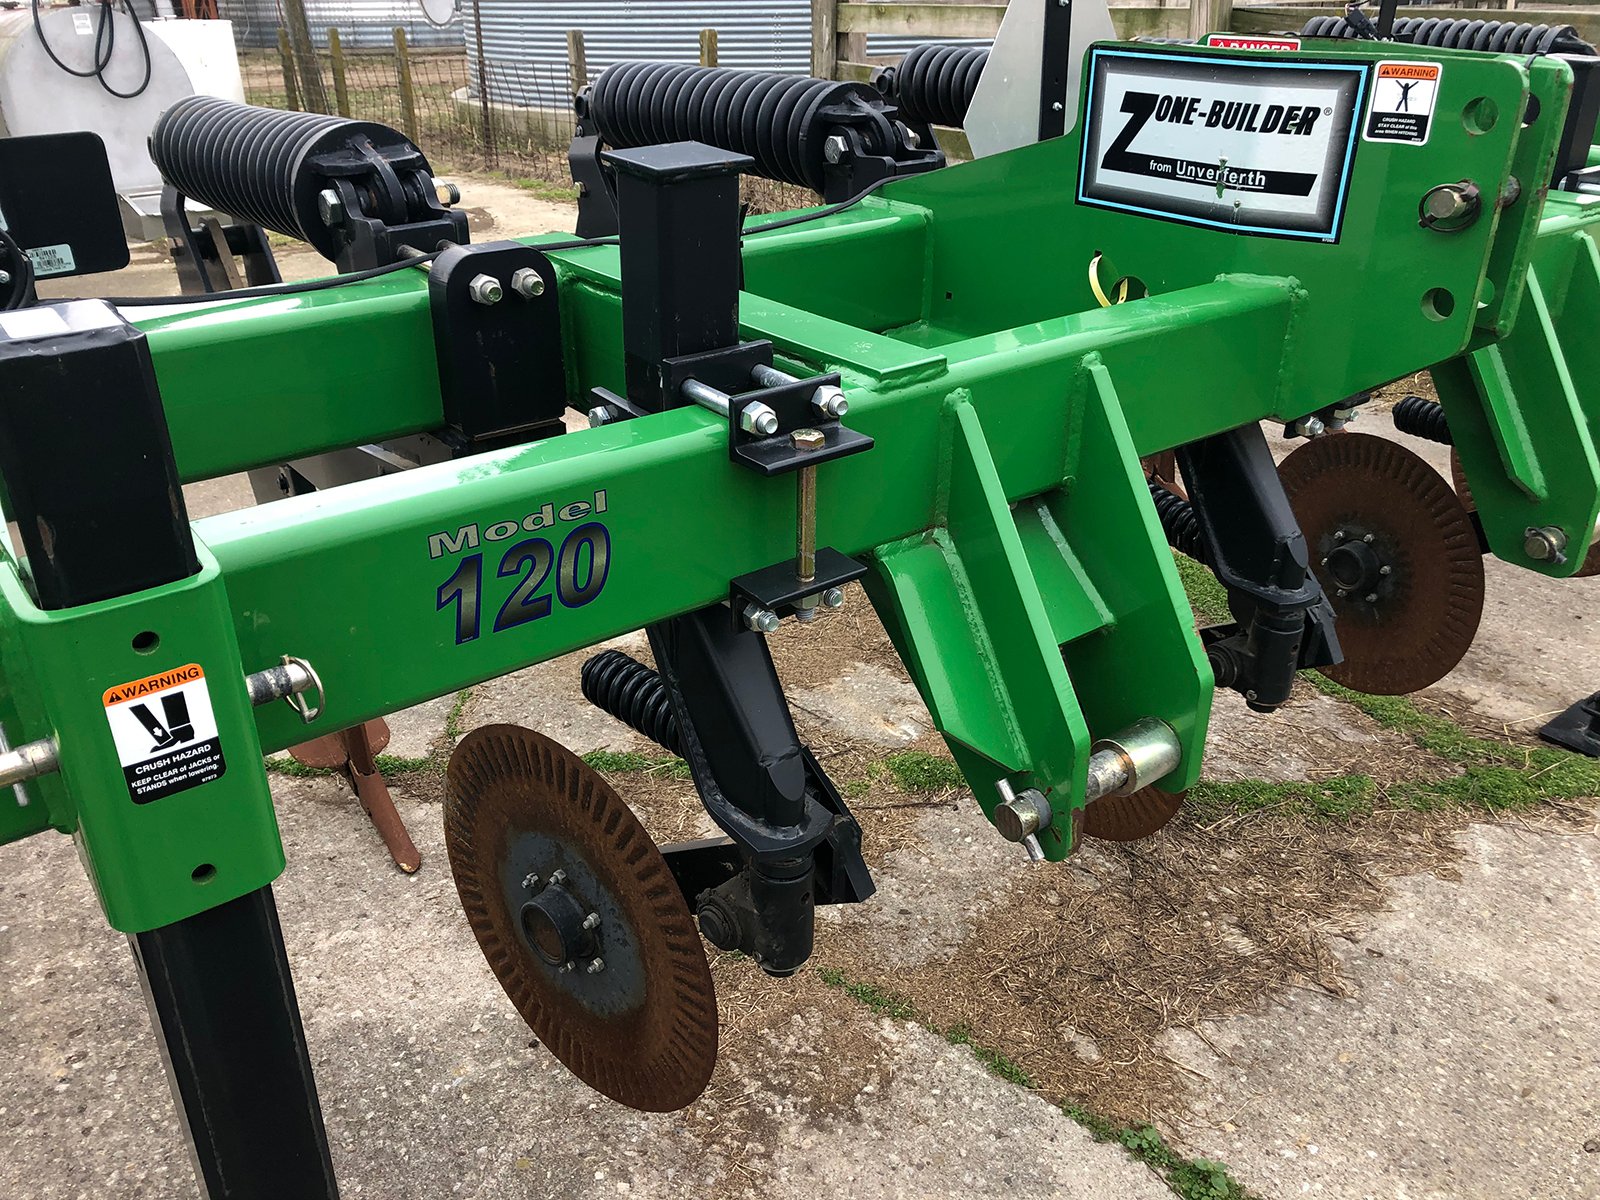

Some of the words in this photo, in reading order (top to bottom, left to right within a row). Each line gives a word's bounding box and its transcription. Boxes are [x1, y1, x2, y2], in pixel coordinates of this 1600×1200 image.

[1391, 68, 1436, 78] WARNING
[1149, 160, 1172, 173] from
[1176, 160, 1267, 187] Unverferth
[427, 488, 608, 559] Model
[436, 521, 612, 646] 120
[121, 667, 200, 699] WARNING
[131, 776, 152, 788] KEEP
[153, 767, 179, 783] CLEAR
[179, 764, 188, 773] of
[188, 756, 212, 771] JACKS
[212, 754, 221, 762] or
[135, 758, 171, 775] CRUSH
[172, 744, 212, 763] HAZARD
[136, 779, 168, 795] STANDS
[168, 773, 188, 785] when
[188, 763, 220, 779] lowering.
